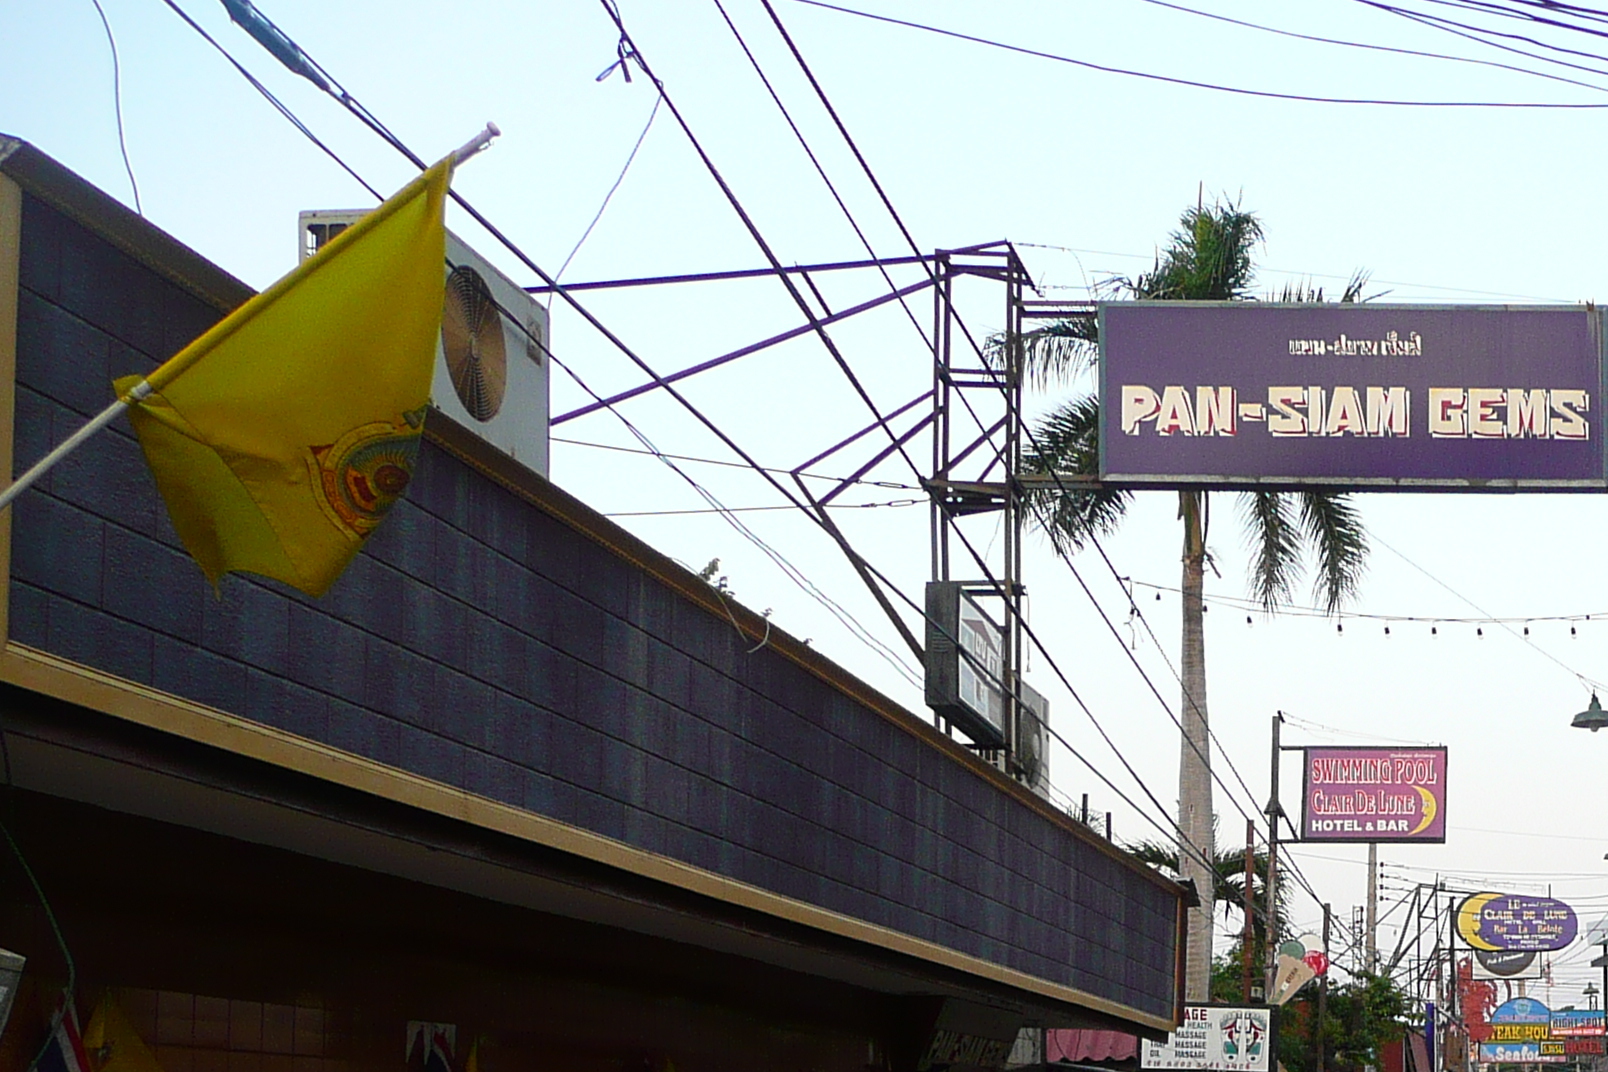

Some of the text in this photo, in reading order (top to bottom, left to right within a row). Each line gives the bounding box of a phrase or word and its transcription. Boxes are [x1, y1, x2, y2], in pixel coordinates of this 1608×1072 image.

[1121, 385, 1590, 440] PAN-SIAM GEMS
[1312, 758, 1437, 784] SWIMMING POOL
[1312, 789, 1415, 815] CLAIR DE LUNE
[1312, 819, 1409, 832] HOTEL & BAR
[1484, 909, 1514, 920] CLAIR
[1544, 910, 1568, 920] LUNE
[1493, 925, 1508, 934] Bar
[1187, 1021, 1212, 1030] HEALTH
[1175, 1031, 1207, 1039] MASSAGE
[1491, 1025, 1548, 1040] TEAK HOU
[1175, 1041, 1207, 1049] MASSAGE
[1175, 1050, 1206, 1058] MASSAGE
